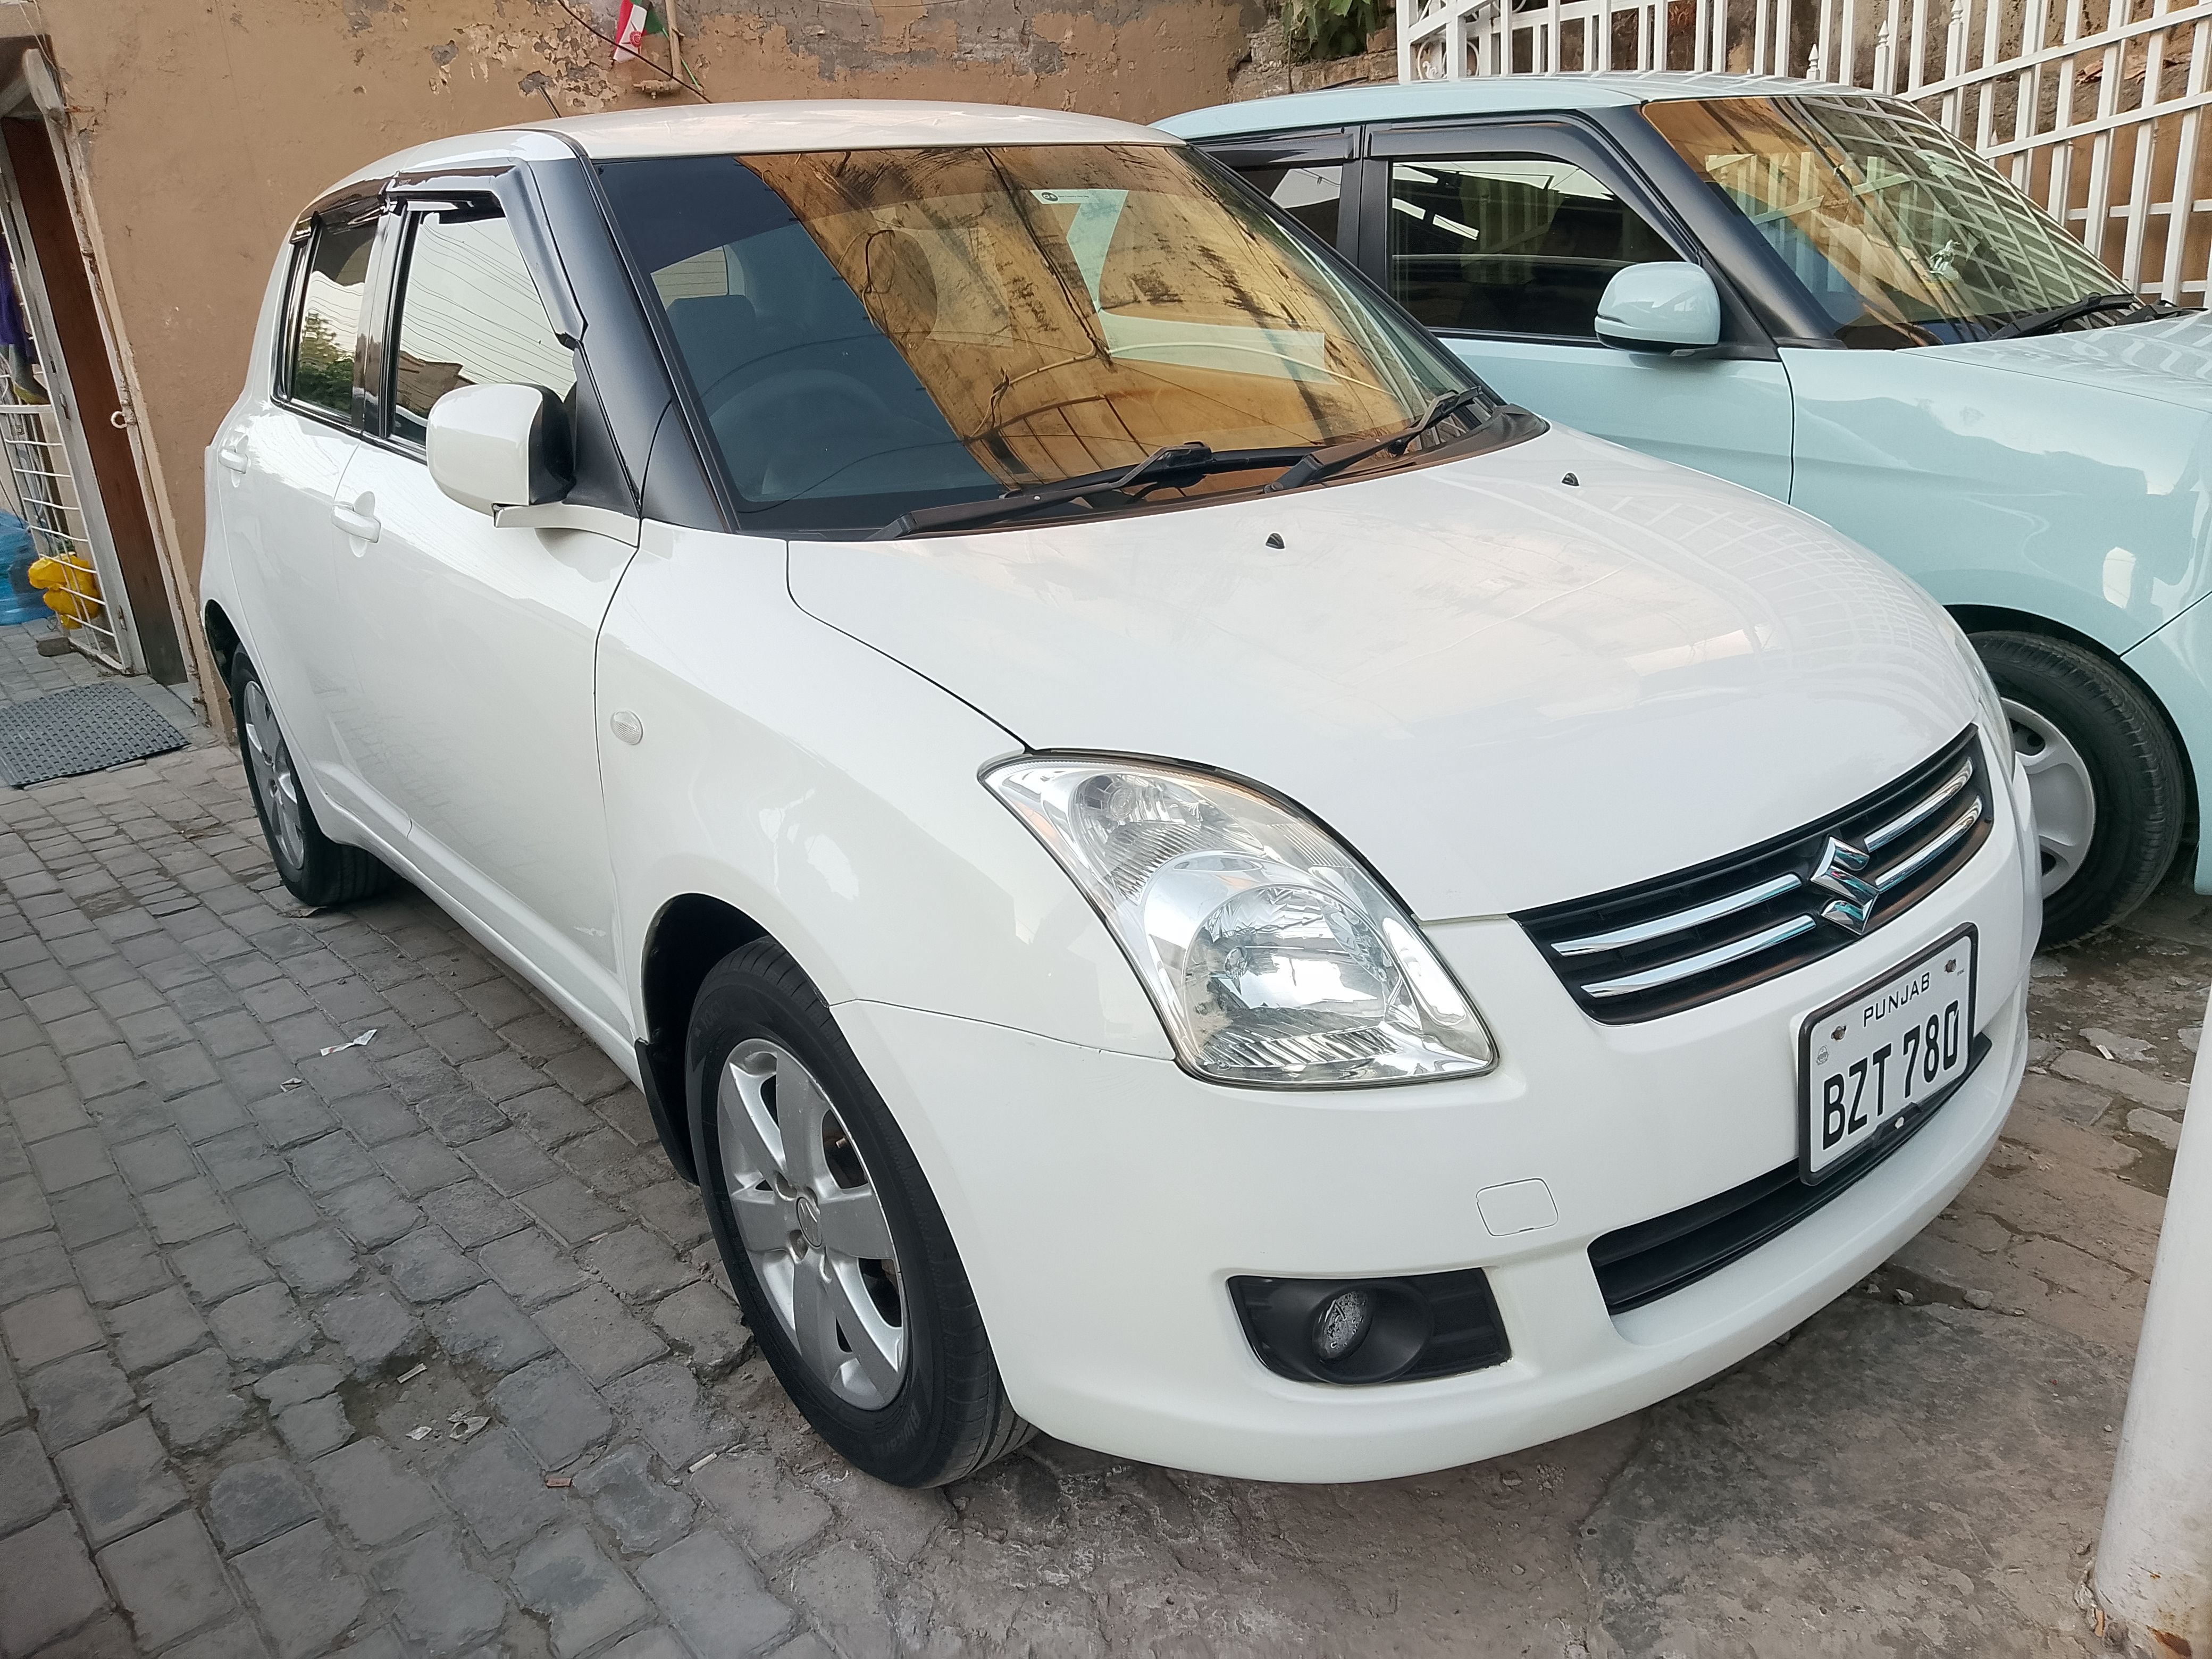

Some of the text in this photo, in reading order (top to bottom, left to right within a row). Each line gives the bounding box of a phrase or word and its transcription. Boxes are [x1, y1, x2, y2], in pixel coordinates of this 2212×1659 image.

[1863, 972, 1930, 1027] PUNJAB
[1823, 1000, 1959, 1151] BZT 780
